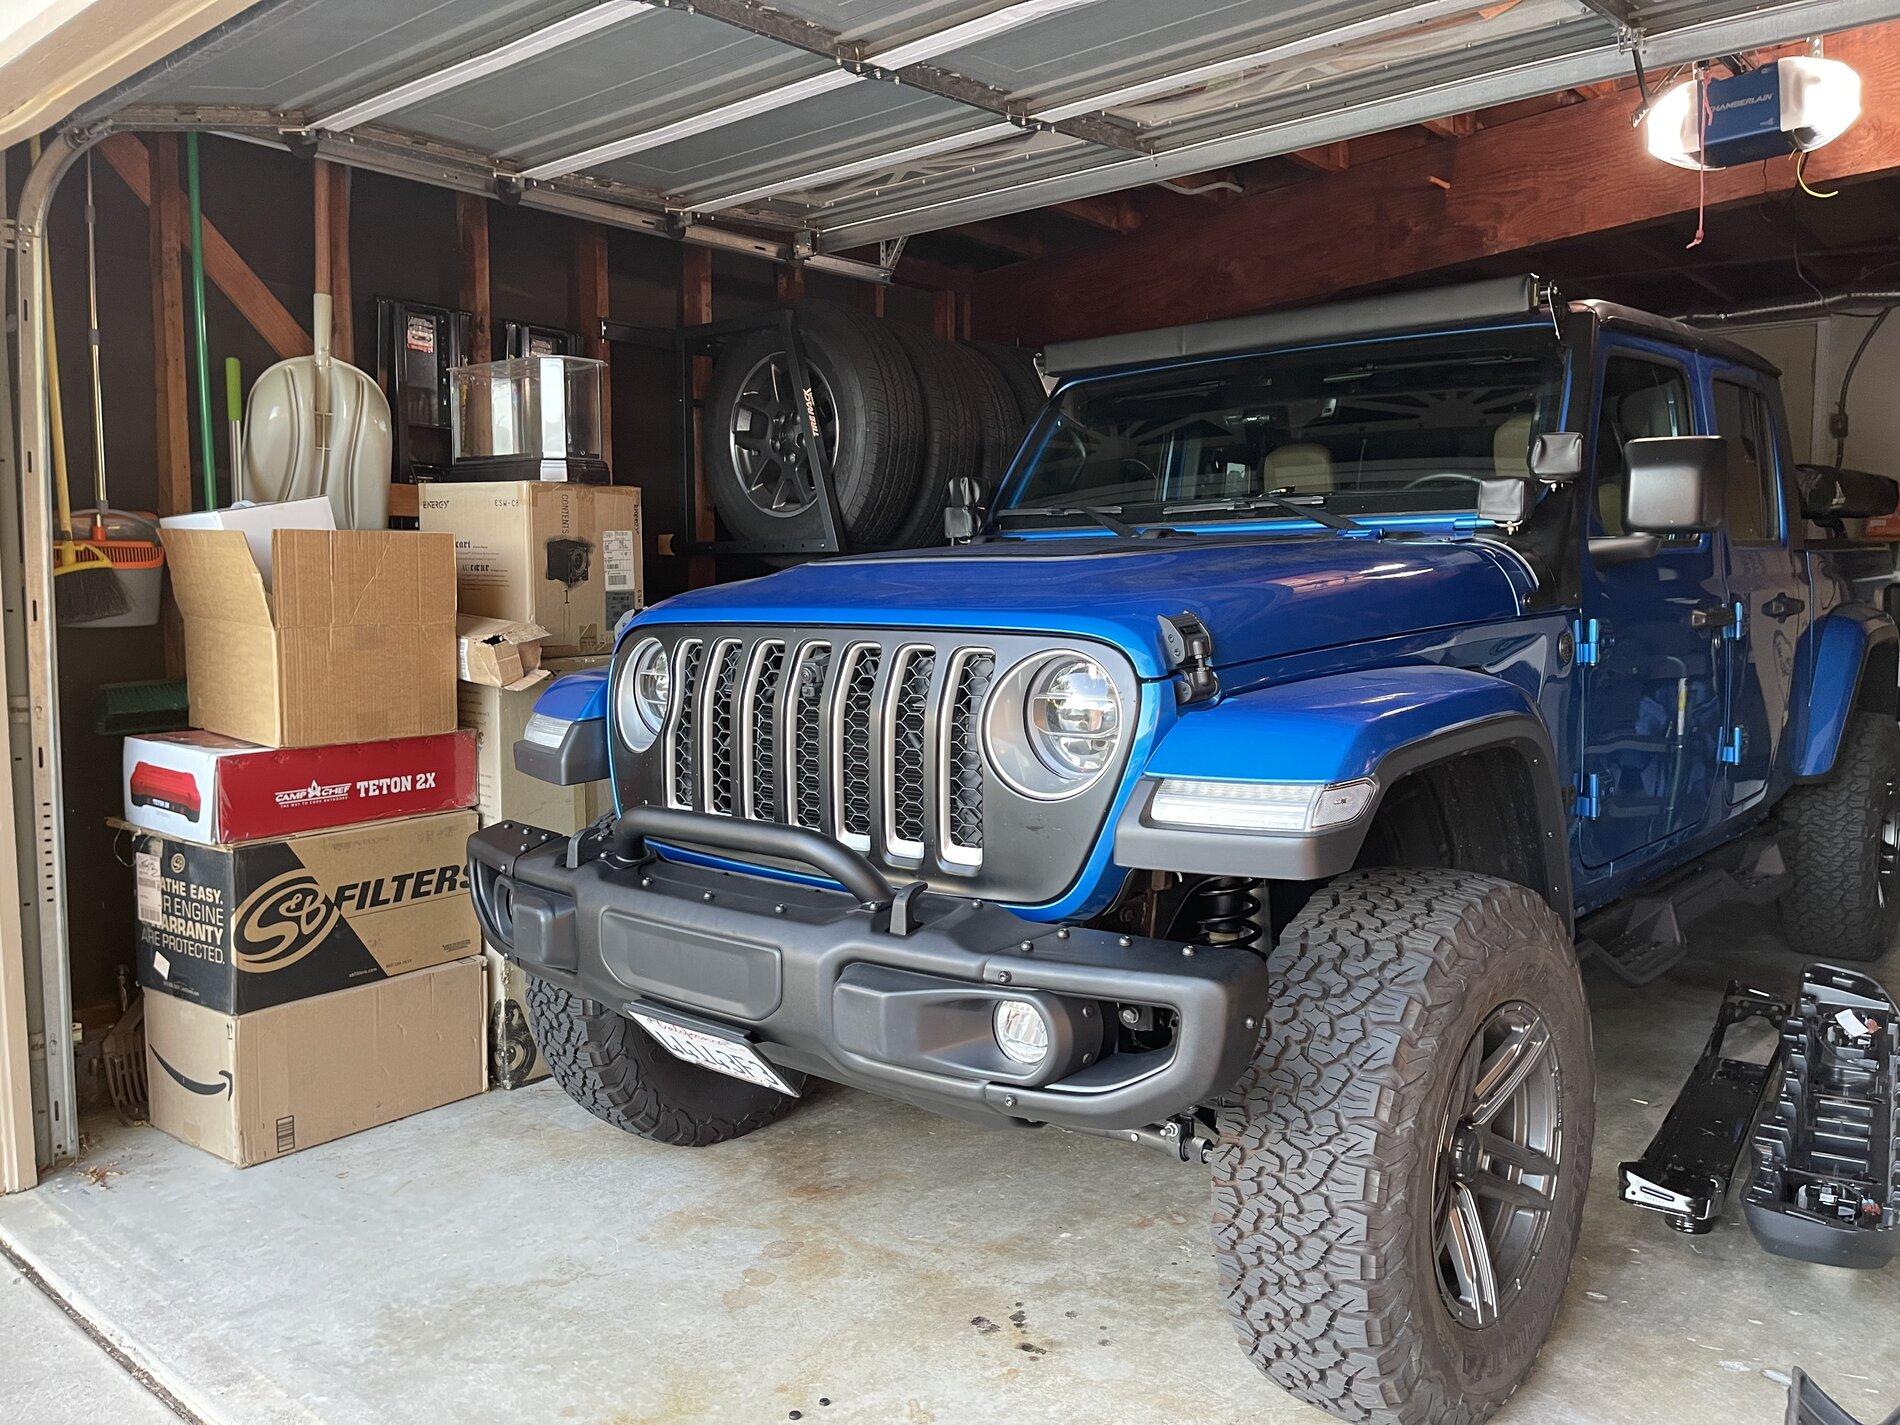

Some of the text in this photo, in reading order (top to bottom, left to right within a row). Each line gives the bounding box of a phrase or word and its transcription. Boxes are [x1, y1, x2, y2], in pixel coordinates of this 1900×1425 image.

[561, 494, 570, 535] CONTENTS
[275, 784, 351, 803] CAMP CHEF
[356, 772, 436, 798] TETON 2X
[161, 876, 186, 897] ATHE
[190, 884, 223, 905] EASY.
[174, 898, 224, 926] ENGINE
[152, 913, 223, 946] ARRANTY
[142, 928, 225, 965] ARE PROTECTED.
